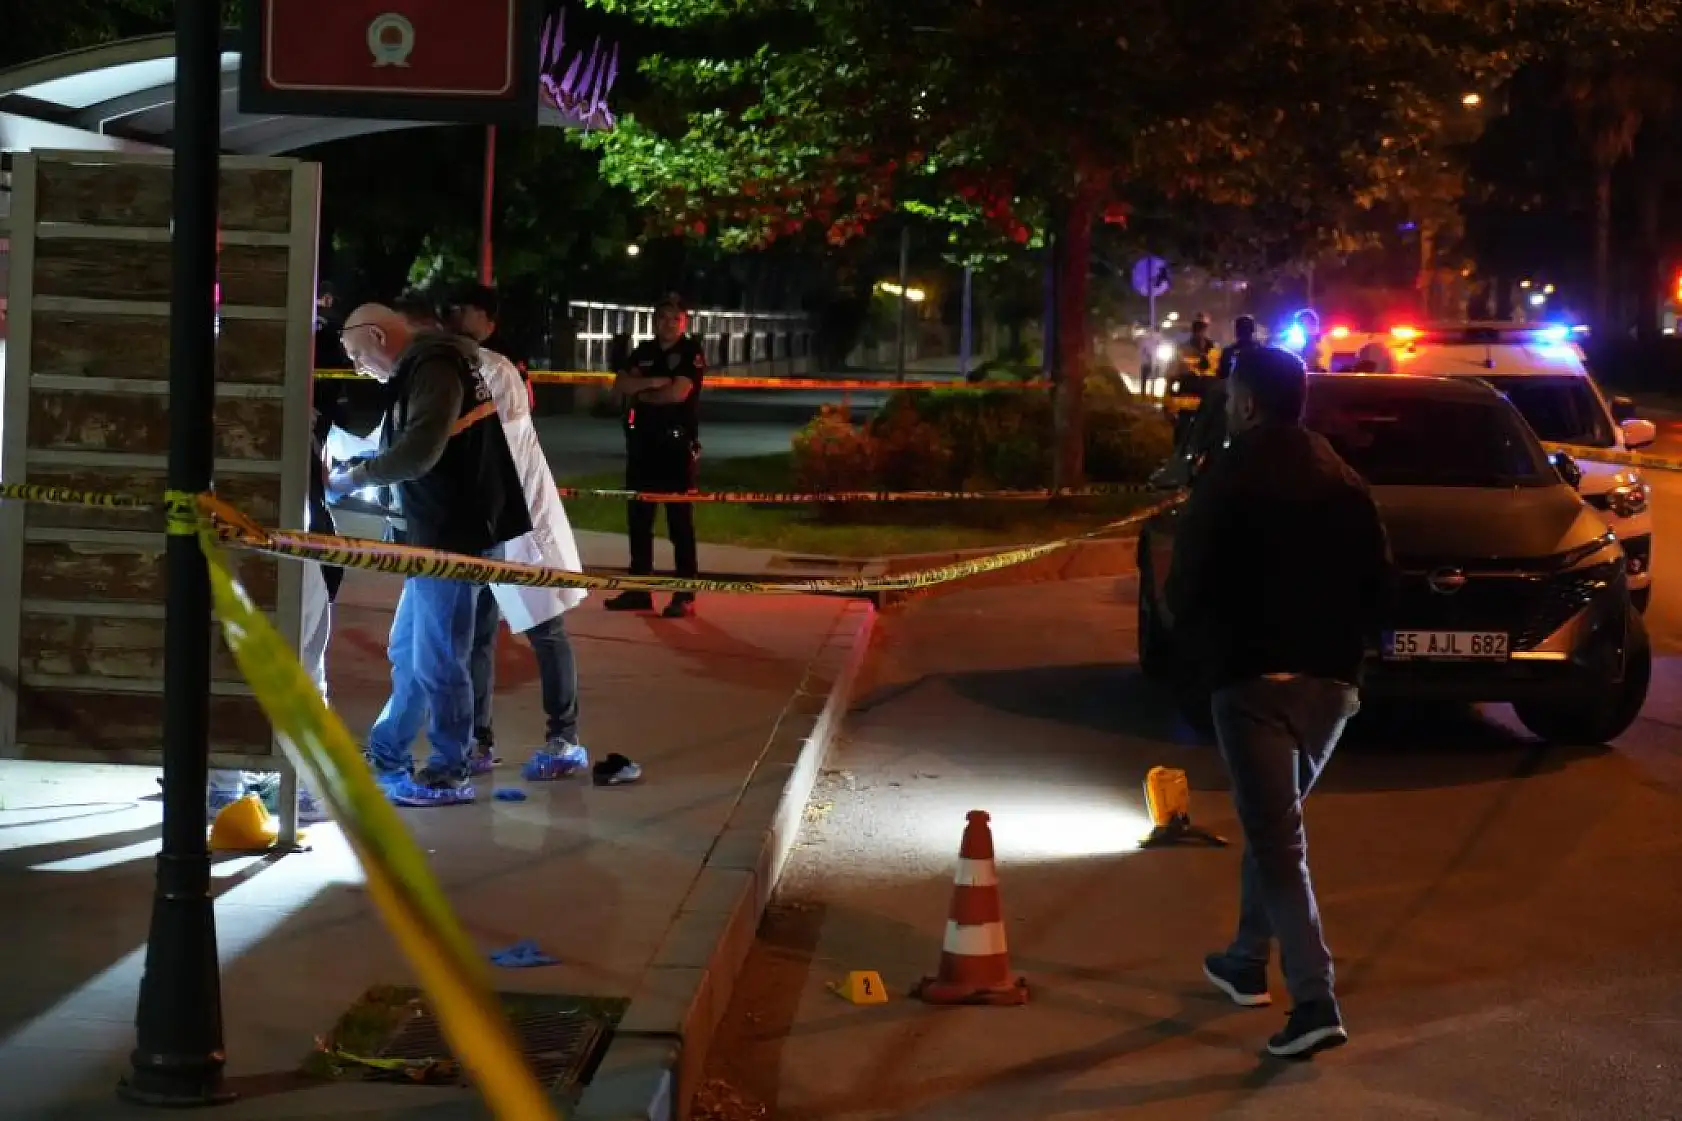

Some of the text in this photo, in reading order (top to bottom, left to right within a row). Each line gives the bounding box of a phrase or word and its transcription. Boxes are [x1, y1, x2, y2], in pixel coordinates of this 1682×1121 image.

[1395, 633, 1505, 655] 55 AJL 682
[862, 976, 873, 996] 2
